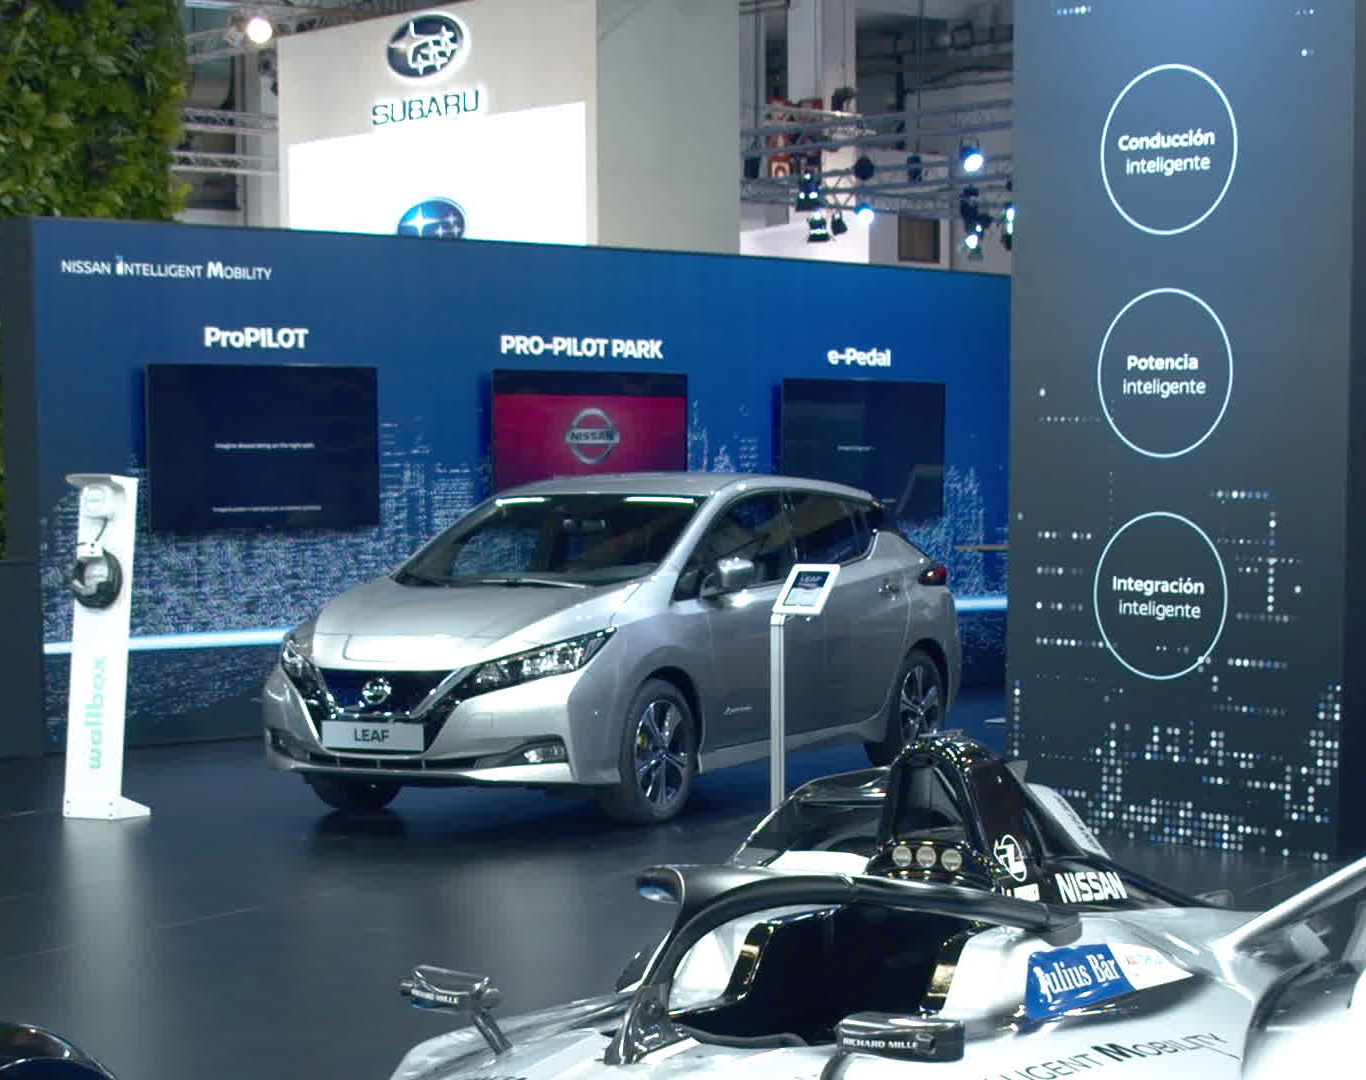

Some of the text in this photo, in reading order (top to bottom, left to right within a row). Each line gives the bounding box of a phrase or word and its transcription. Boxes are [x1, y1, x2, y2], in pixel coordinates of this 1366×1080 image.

[372, 90, 480, 125] SUBARU
[1118, 128, 1216, 151] Conducción
[1126, 155, 1211, 176] inteligente
[61, 257, 272, 280] NISSAN INTELLIGENT MOBILITY
[204, 326, 309, 349] ProPILOT
[501, 334, 663, 360] PRO-PILOT PARK
[827, 347, 891, 367] e-Pedal
[1127, 355, 1198, 371] Potencia
[1123, 378, 1206, 398] inteligente
[1112, 576, 1205, 597] Integración
[1118, 600, 1201, 620] inteligente
[85, 656, 107, 770] wallbox
[354, 729, 389, 743] LEAF
[1055, 872, 1128, 904] NISSAN
[1033, 961, 1092, 1003] Julius
[1086, 954, 1121, 982] Bär
[843, 1037, 885, 1049] RICHARD
[1091, 1032, 1230, 1062] MOBILITY
